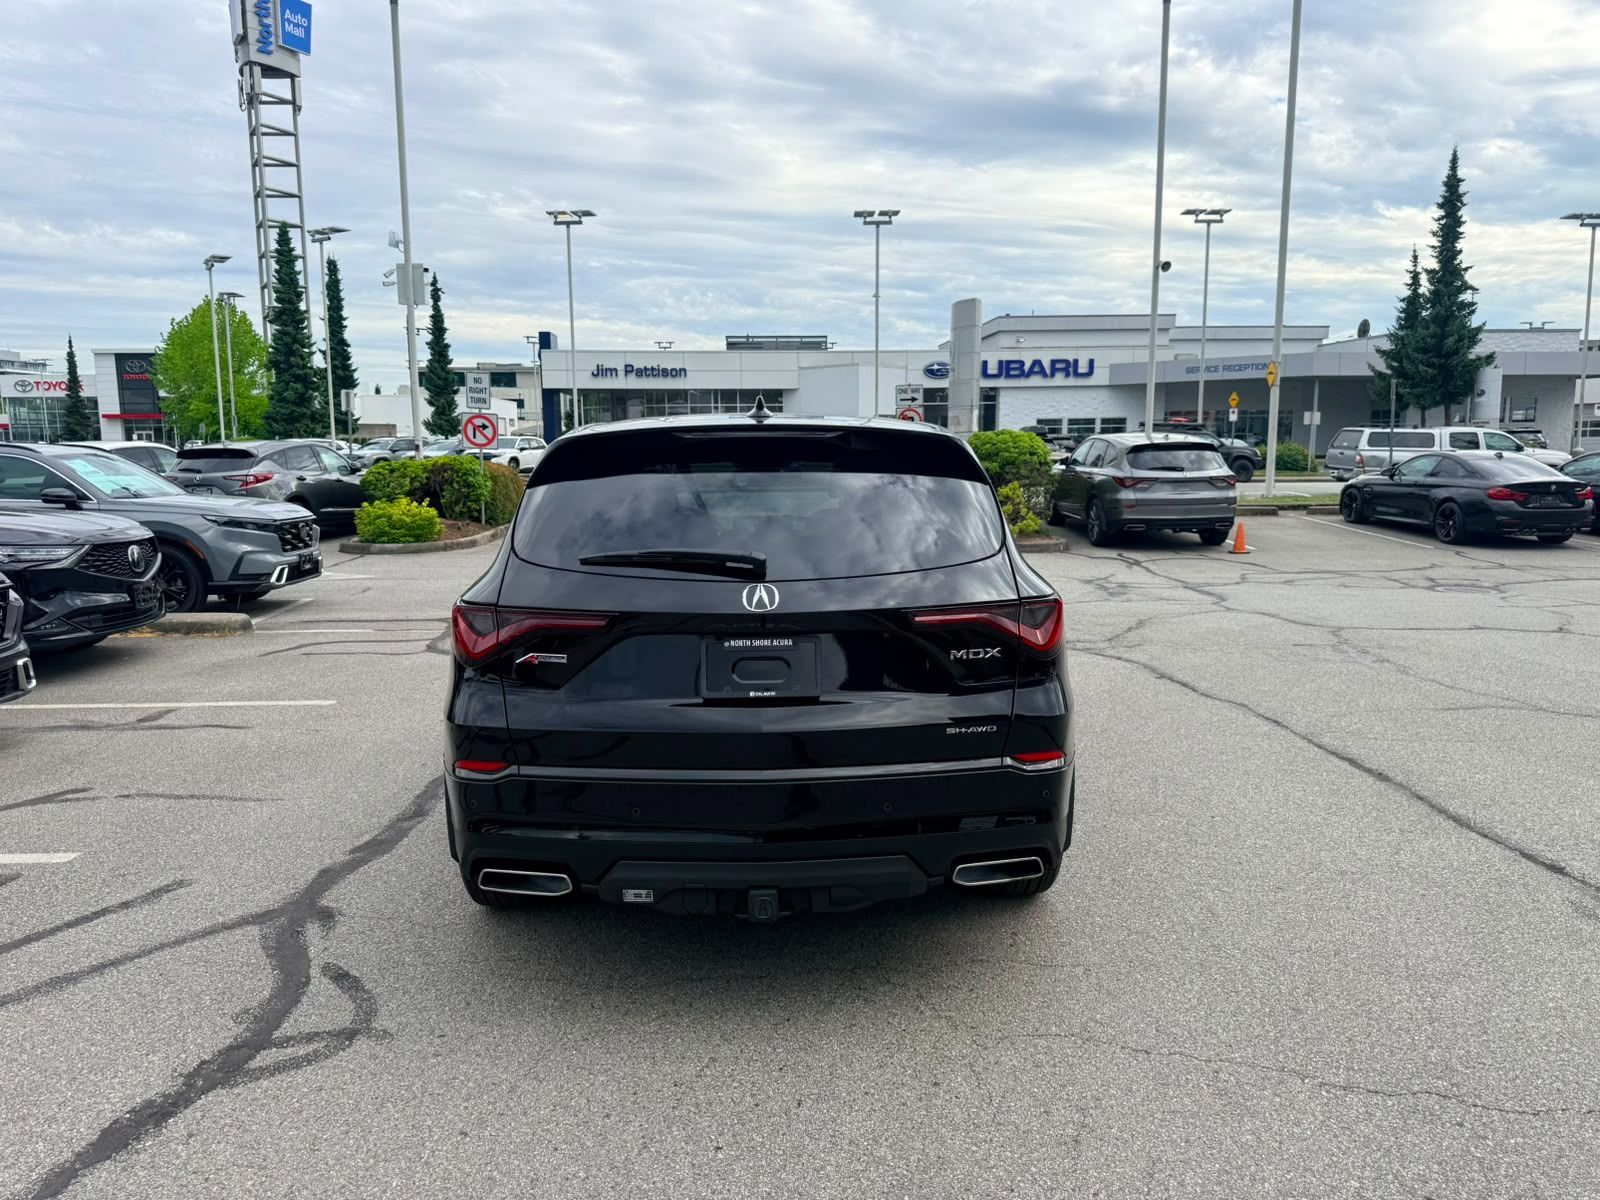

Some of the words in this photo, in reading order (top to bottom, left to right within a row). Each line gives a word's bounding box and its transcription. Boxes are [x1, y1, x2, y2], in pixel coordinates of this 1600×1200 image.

[284, 9, 308, 26] Auto
[284, 21, 305, 38] Mall
[592, 363, 618, 378] Jim
[624, 363, 687, 378] Pattison
[982, 359, 1095, 378] UBARU
[1222, 363, 1268, 373] RECEPTION
[473, 376, 483, 385] NO
[33, 381, 84, 392] TOYO
[468, 386, 488, 395] RIGHT
[470, 396, 487, 405] TURN
[730, 639, 751, 647] NORTH
[752, 639, 772, 647] SHORE
[773, 638, 793, 646] ACURA
[949, 647, 1002, 660] MDX
[946, 725, 997, 735] SH-AWD
